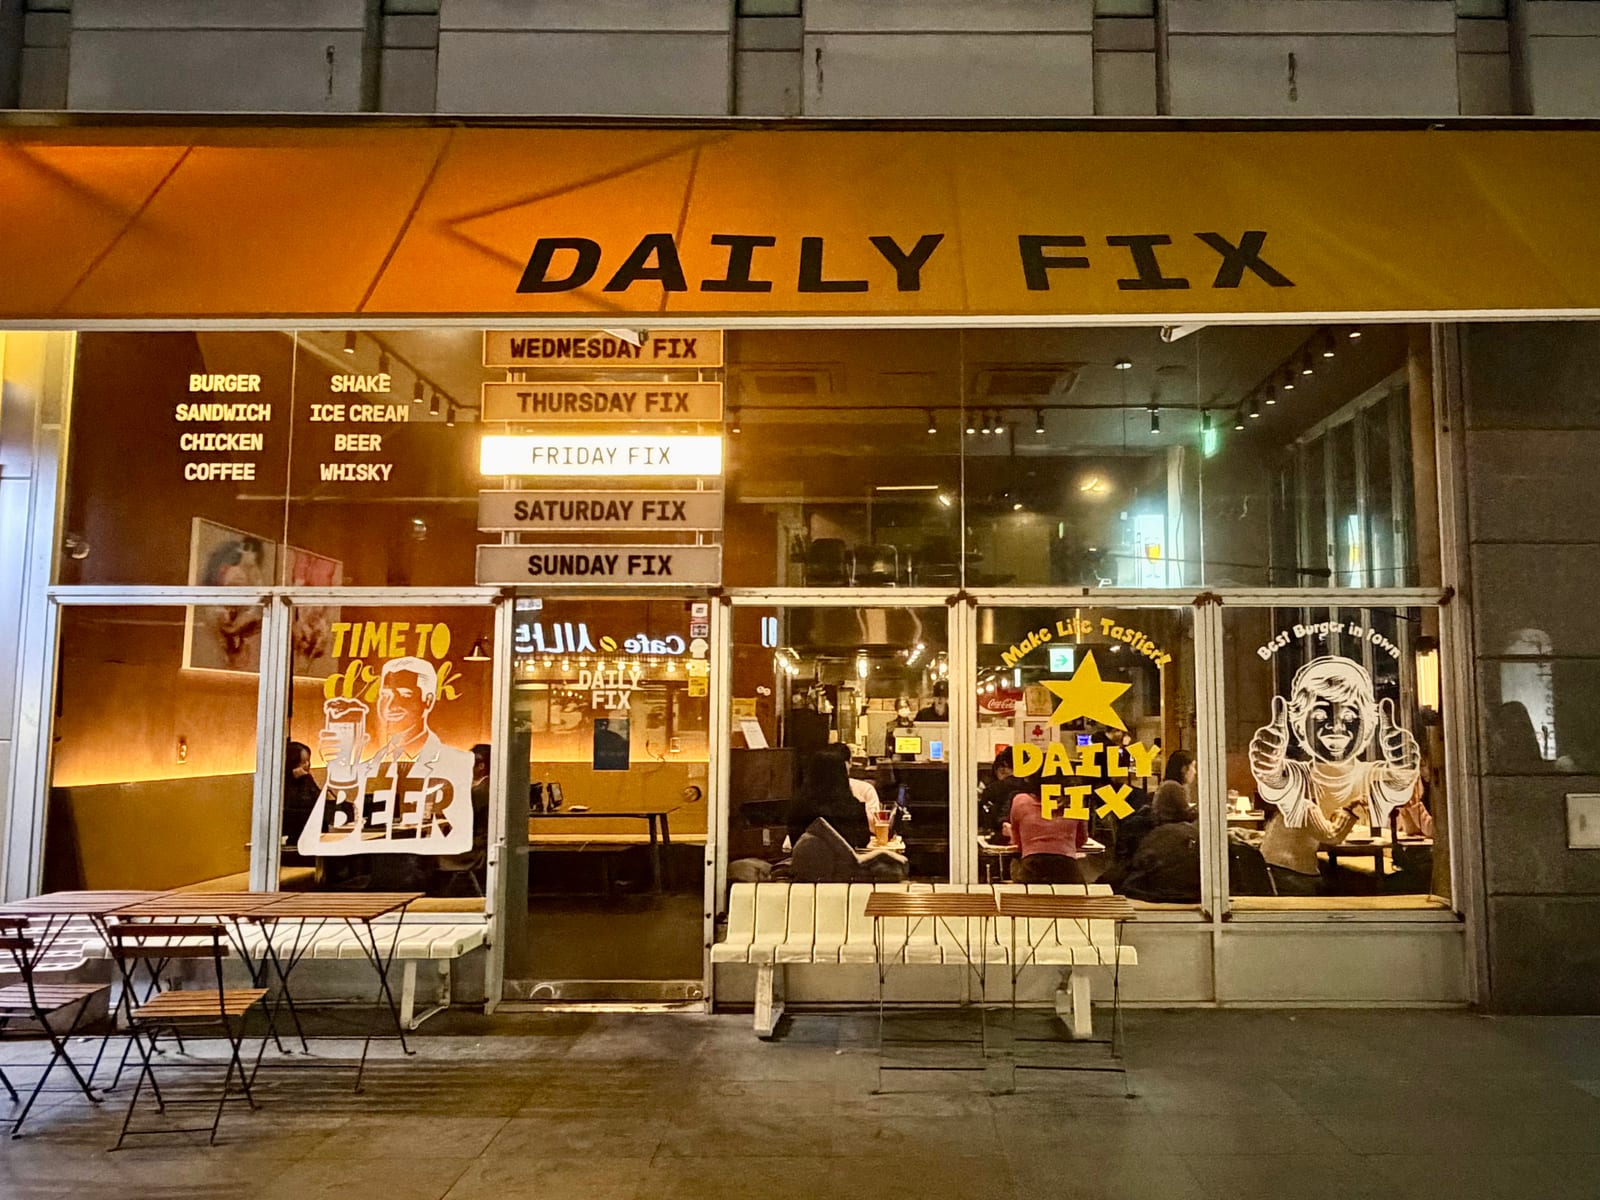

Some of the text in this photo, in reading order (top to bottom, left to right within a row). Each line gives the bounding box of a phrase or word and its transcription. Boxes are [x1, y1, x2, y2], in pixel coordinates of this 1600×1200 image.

[516, 231, 1295, 294] DAILY FIX
[511, 338, 697, 358] WEDNESDAY FIX
[189, 374, 260, 393] BURGER
[330, 374, 391, 393] SHAKE
[175, 403, 271, 422] SANDWICH
[516, 392, 689, 413] THURSDAY FIX
[309, 404, 409, 422] ICE CREAM
[180, 433, 263, 451] CHICKEN
[335, 433, 381, 452] BEER
[532, 447, 671, 465] FRIDAY FIX
[184, 463, 256, 481] COFFEE
[320, 463, 392, 482] WHISKY
[514, 500, 686, 521] SATURDAY FIX
[528, 554, 672, 576] SUNDAY FIX
[331, 621, 451, 659] TIME TO
[1000, 627, 1053, 668] Make
[1100, 617, 1172, 669] Tastier!
[1256, 621, 1401, 661] Best Burger in town
[579, 669, 642, 690] DAILY
[591, 690, 631, 710] FIX
[1012, 741, 1161, 778] DAILY
[319, 776, 455, 843] BEER
[1040, 784, 1136, 820] FIX
